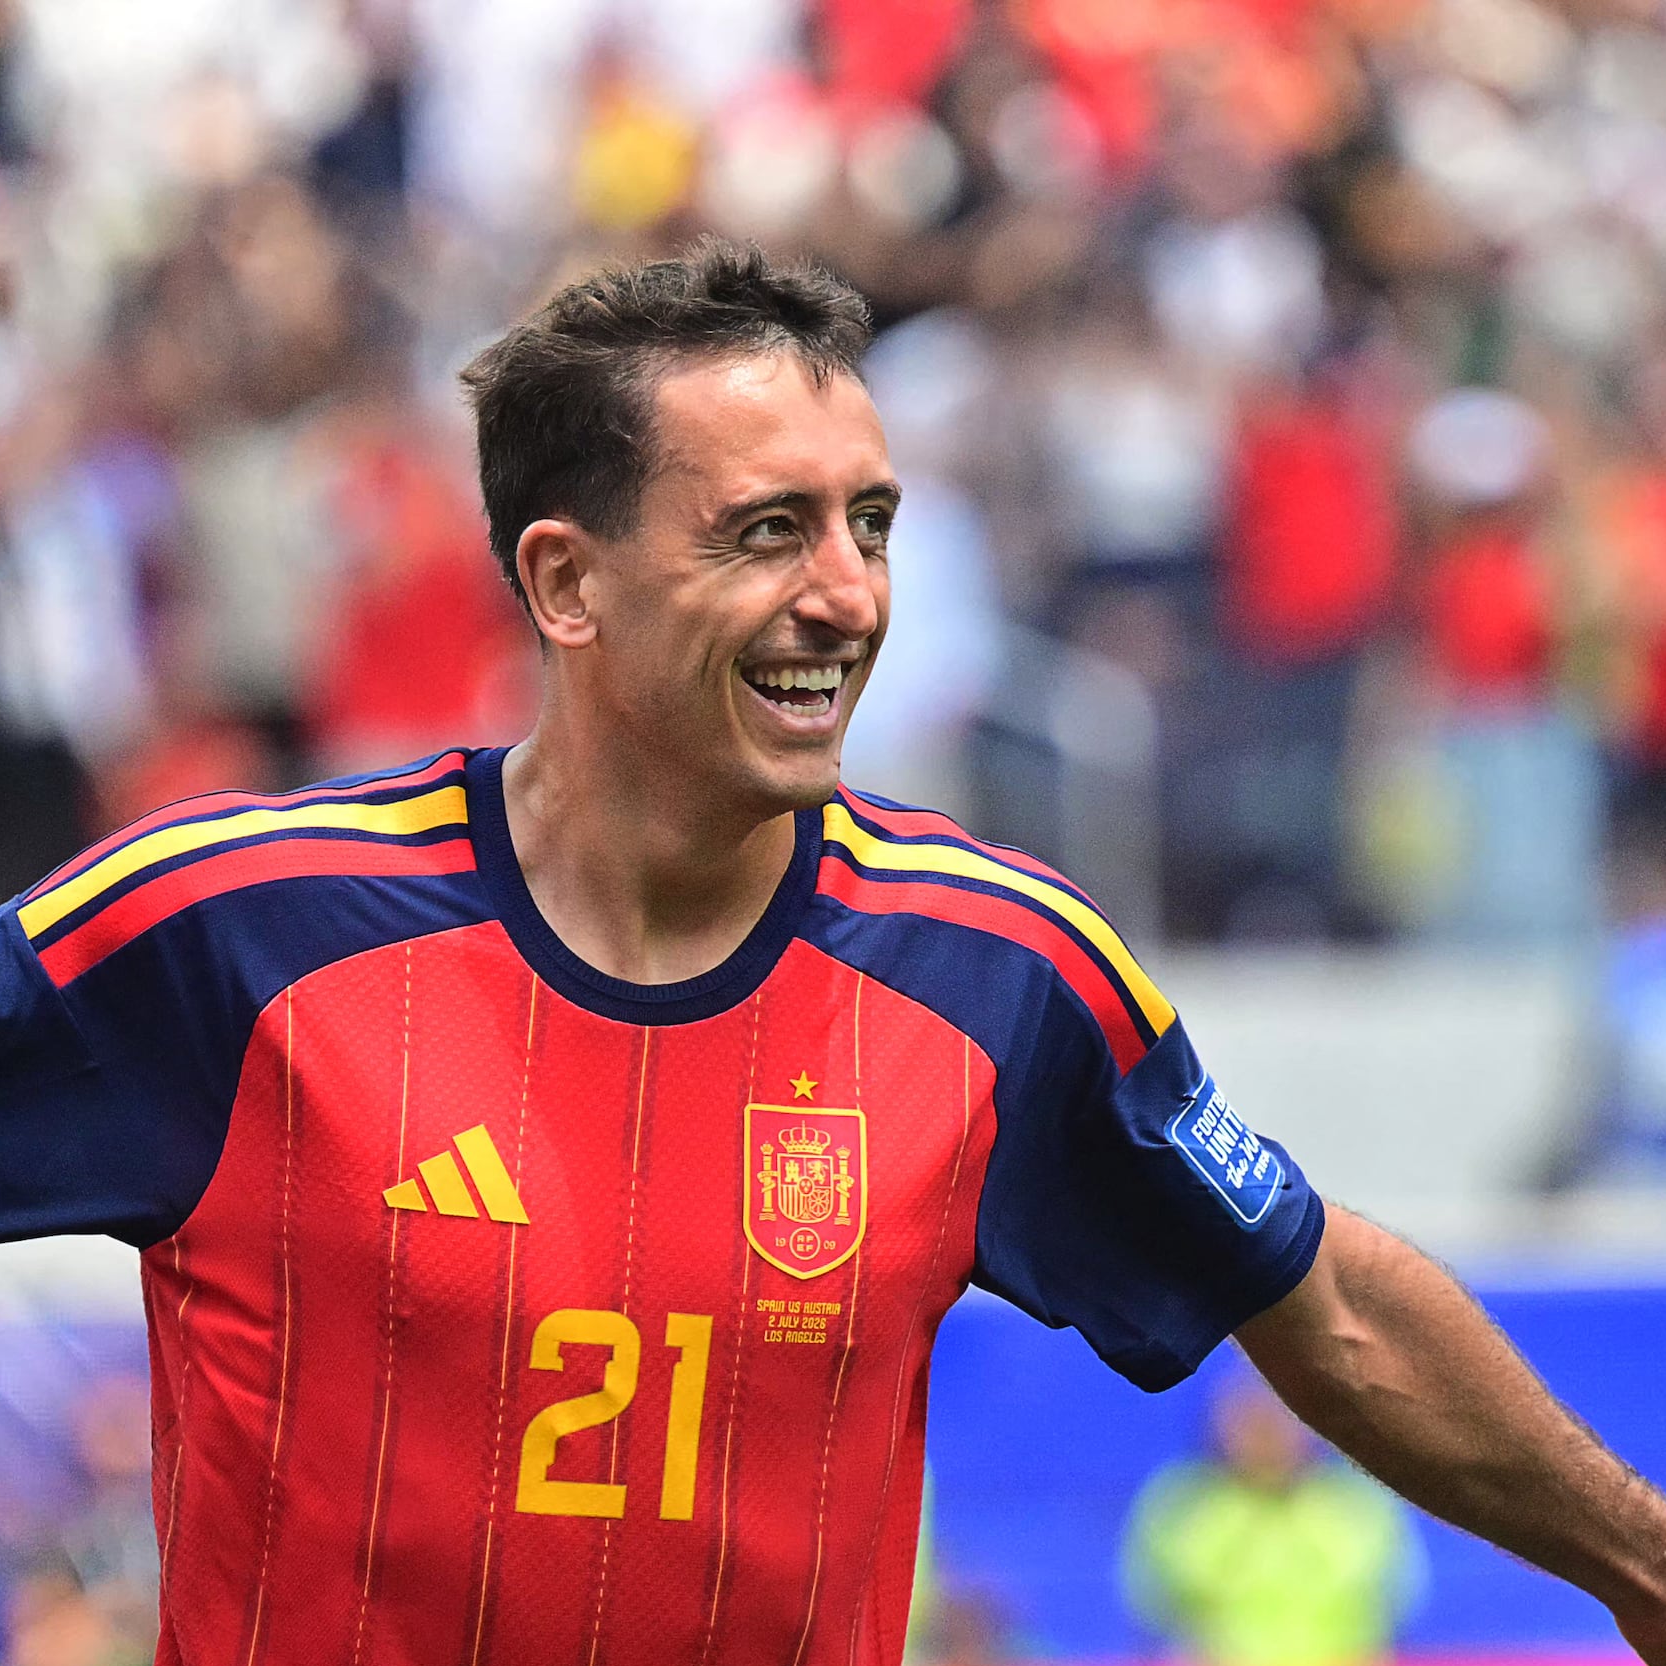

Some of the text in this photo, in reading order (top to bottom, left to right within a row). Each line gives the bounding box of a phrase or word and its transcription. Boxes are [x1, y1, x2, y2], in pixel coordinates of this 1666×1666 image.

[1191, 1086, 1226, 1145] FOOTB
[1204, 1102, 1244, 1166] UNIT
[1226, 1157, 1249, 1189] the
[1252, 1149, 1270, 1181] FIFA
[775, 1236, 787, 1248] 19
[823, 1239, 836, 1250] 09
[756, 1299, 786, 1313] SPAIN
[803, 1302, 841, 1316] AUSTRIA
[768, 1315, 827, 1330] 2 JULY 2026
[763, 1330, 827, 1344] LOS ANGELES
[515, 1308, 713, 1521] 21
